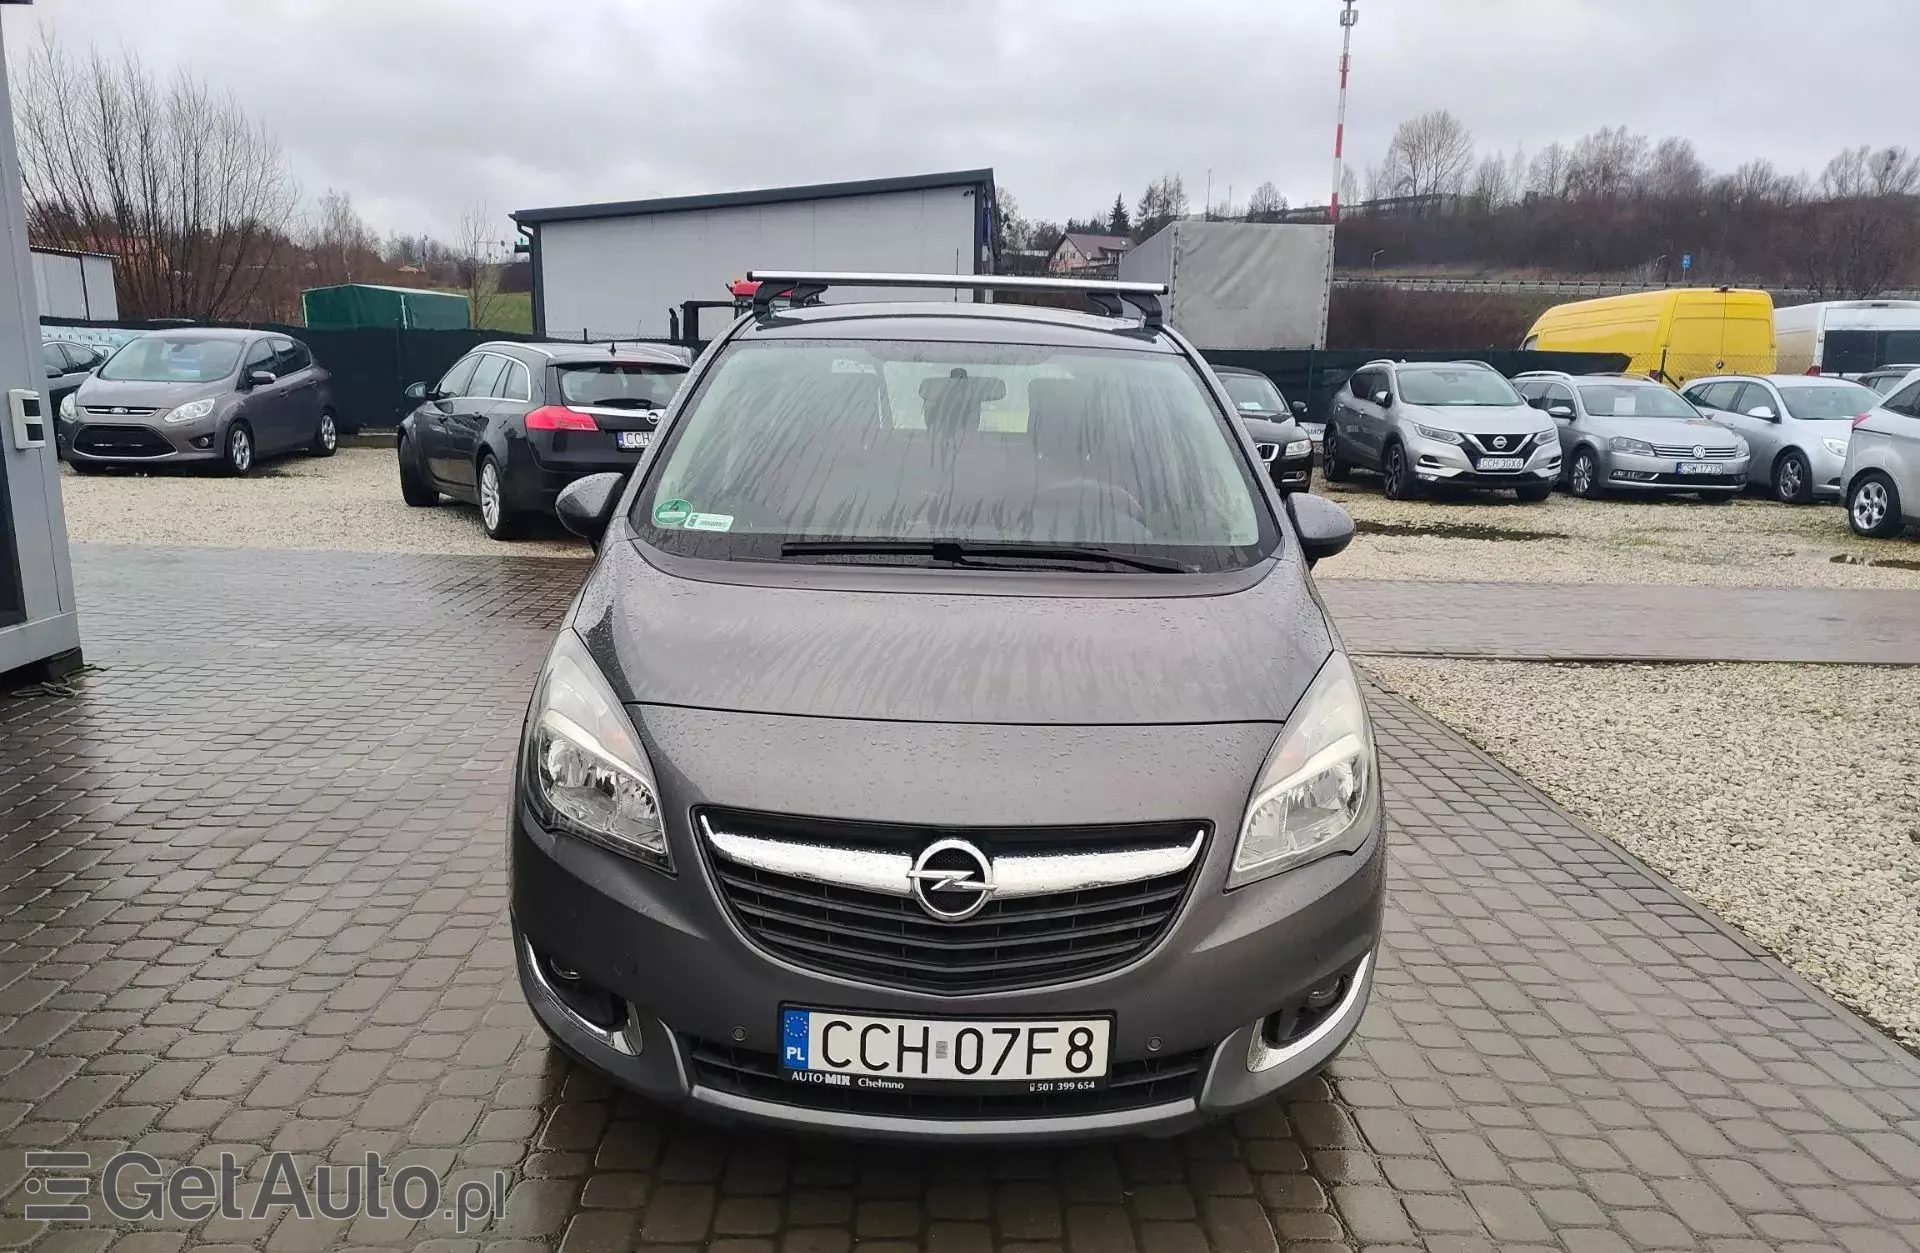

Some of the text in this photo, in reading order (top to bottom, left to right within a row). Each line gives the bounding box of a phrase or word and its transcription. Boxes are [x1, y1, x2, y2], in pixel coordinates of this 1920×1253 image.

[626, 432, 650, 445] CCH
[786, 1046, 806, 1061] PL
[822, 1020, 1095, 1076] CCH 07F8
[1036, 1081, 1096, 1092] 501 399 654
